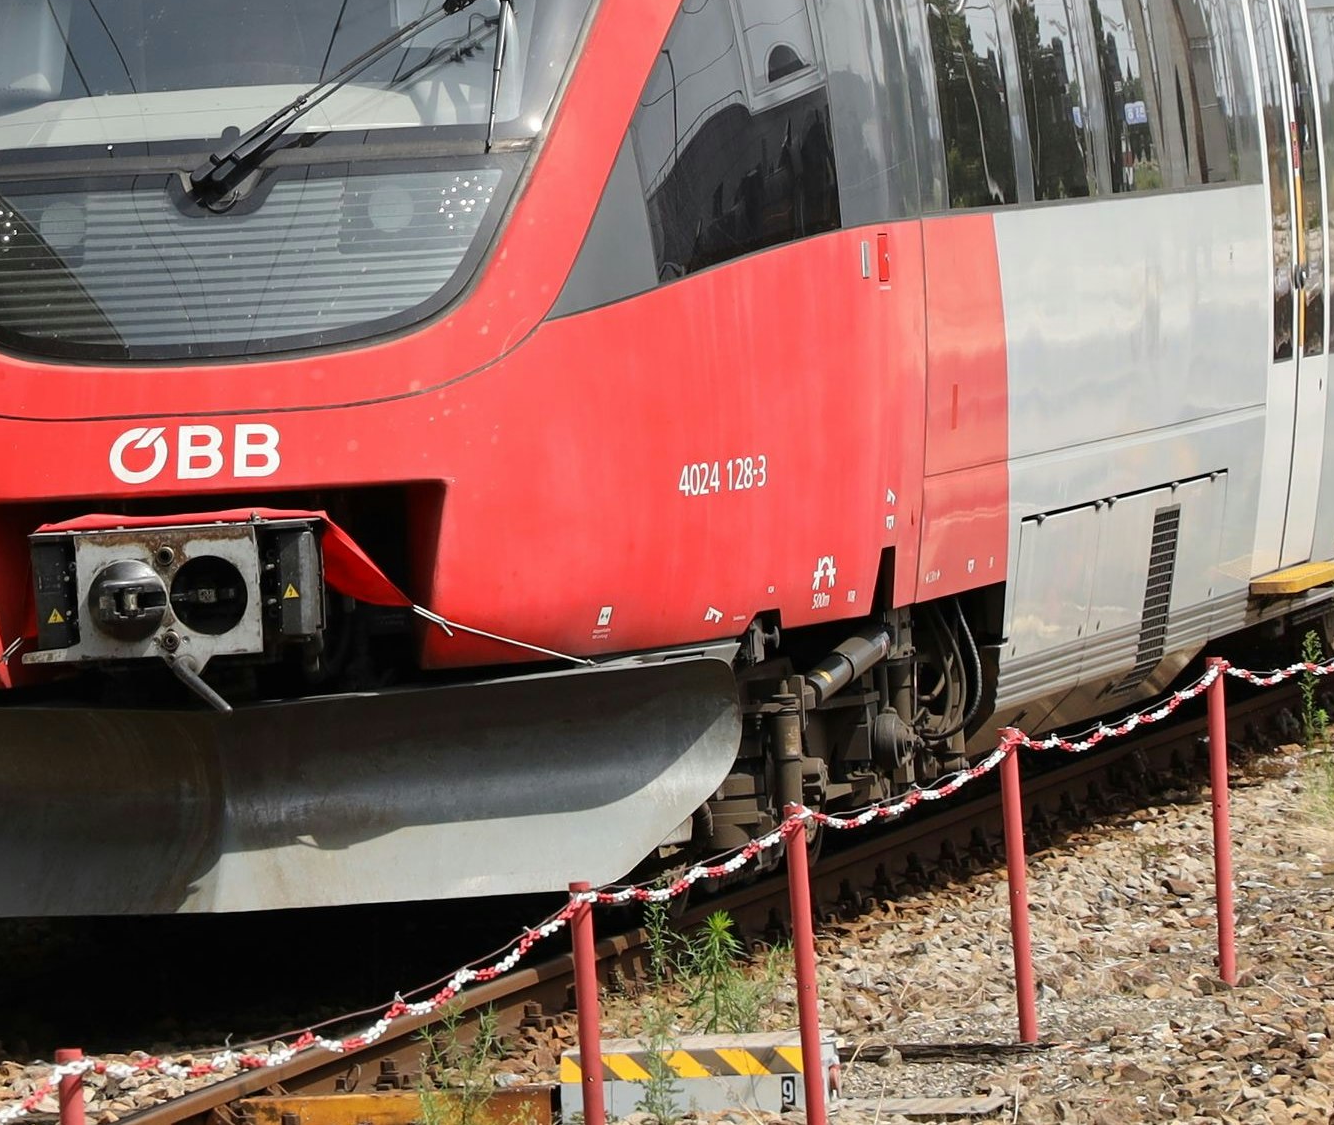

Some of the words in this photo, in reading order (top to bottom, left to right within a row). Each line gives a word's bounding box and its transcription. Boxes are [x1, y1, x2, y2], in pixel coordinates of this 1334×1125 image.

[109, 423, 281, 484] ÖBB
[678, 461, 721, 497] 4024
[726, 454, 767, 491] 128-3
[782, 1079, 795, 1103] 9
